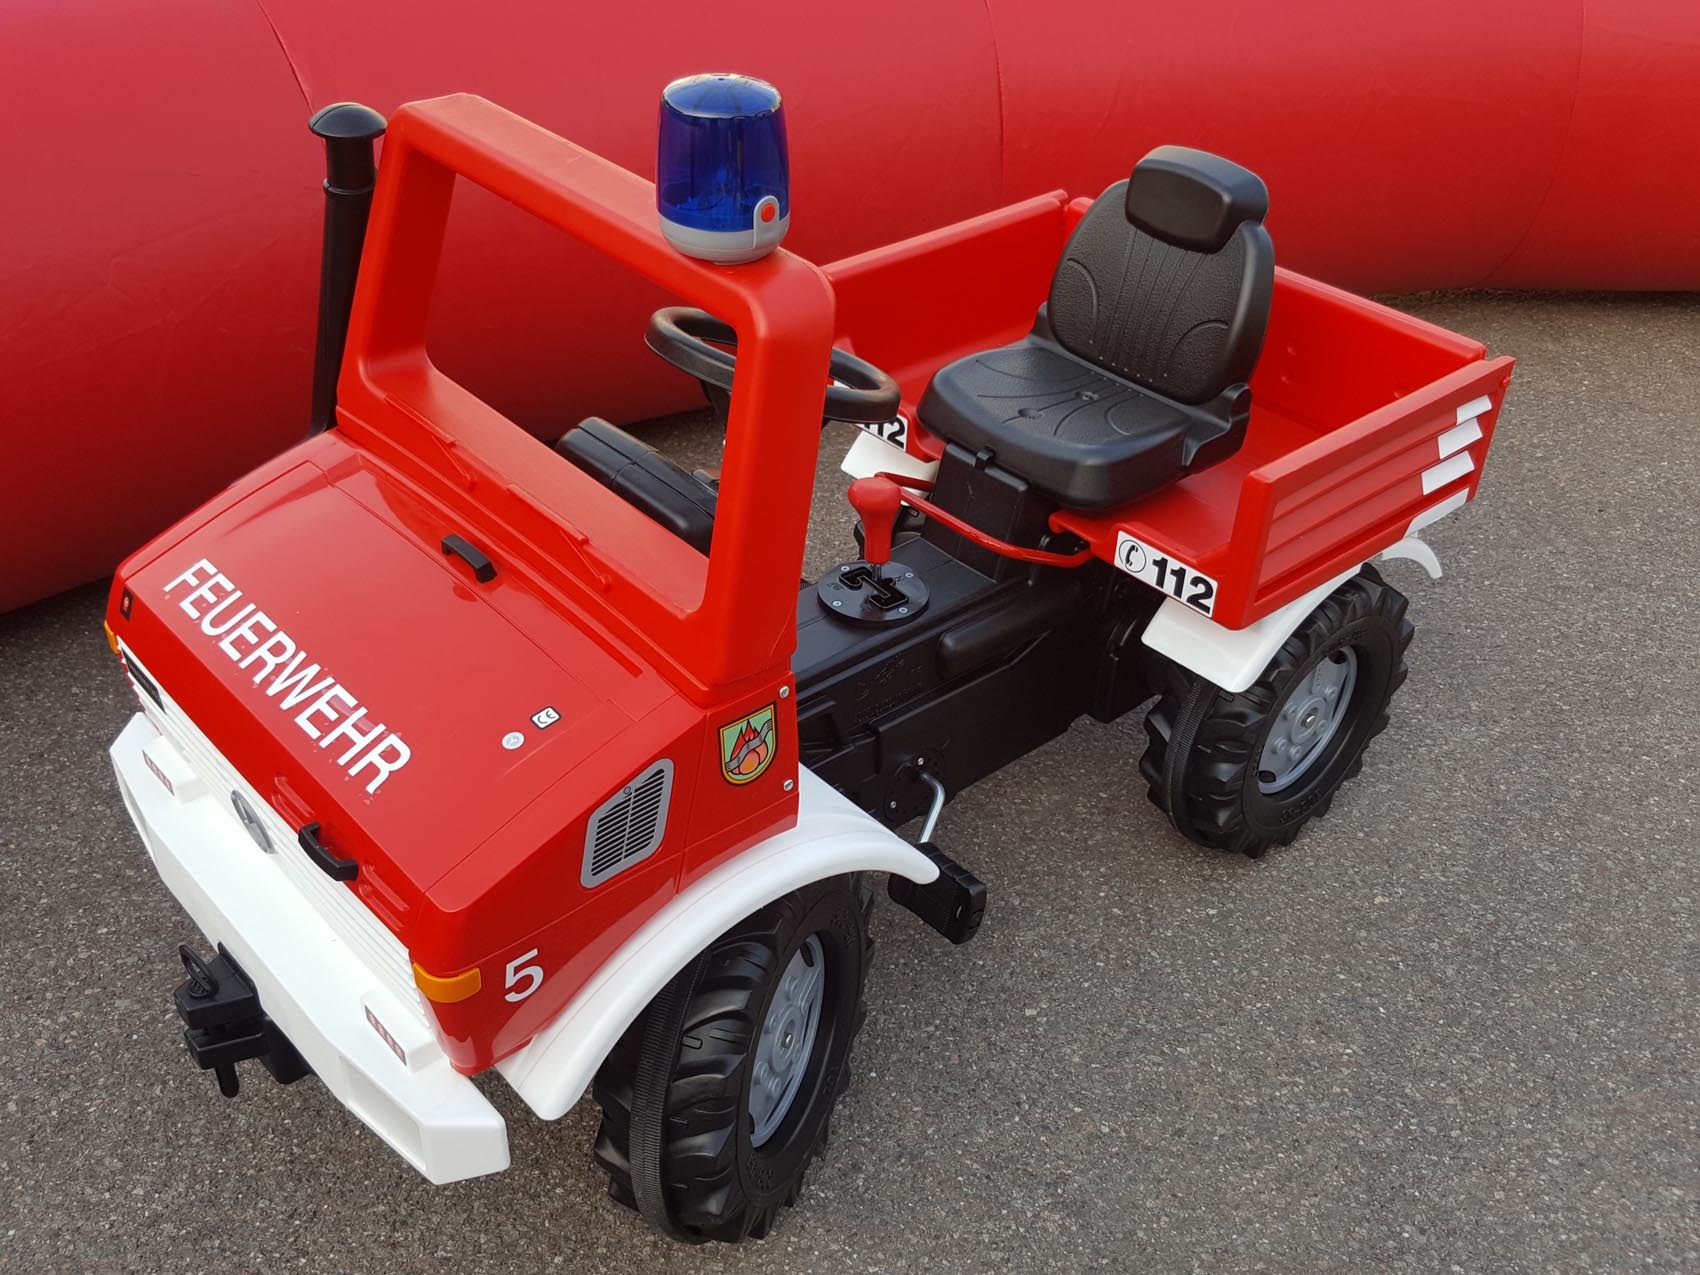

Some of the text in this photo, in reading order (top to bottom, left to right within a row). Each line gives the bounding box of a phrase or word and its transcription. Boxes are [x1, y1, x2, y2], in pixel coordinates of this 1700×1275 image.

[1152, 557, 1214, 615] 112
[163, 558, 412, 795] FEUERWEHR
[504, 948, 544, 1003] 5
